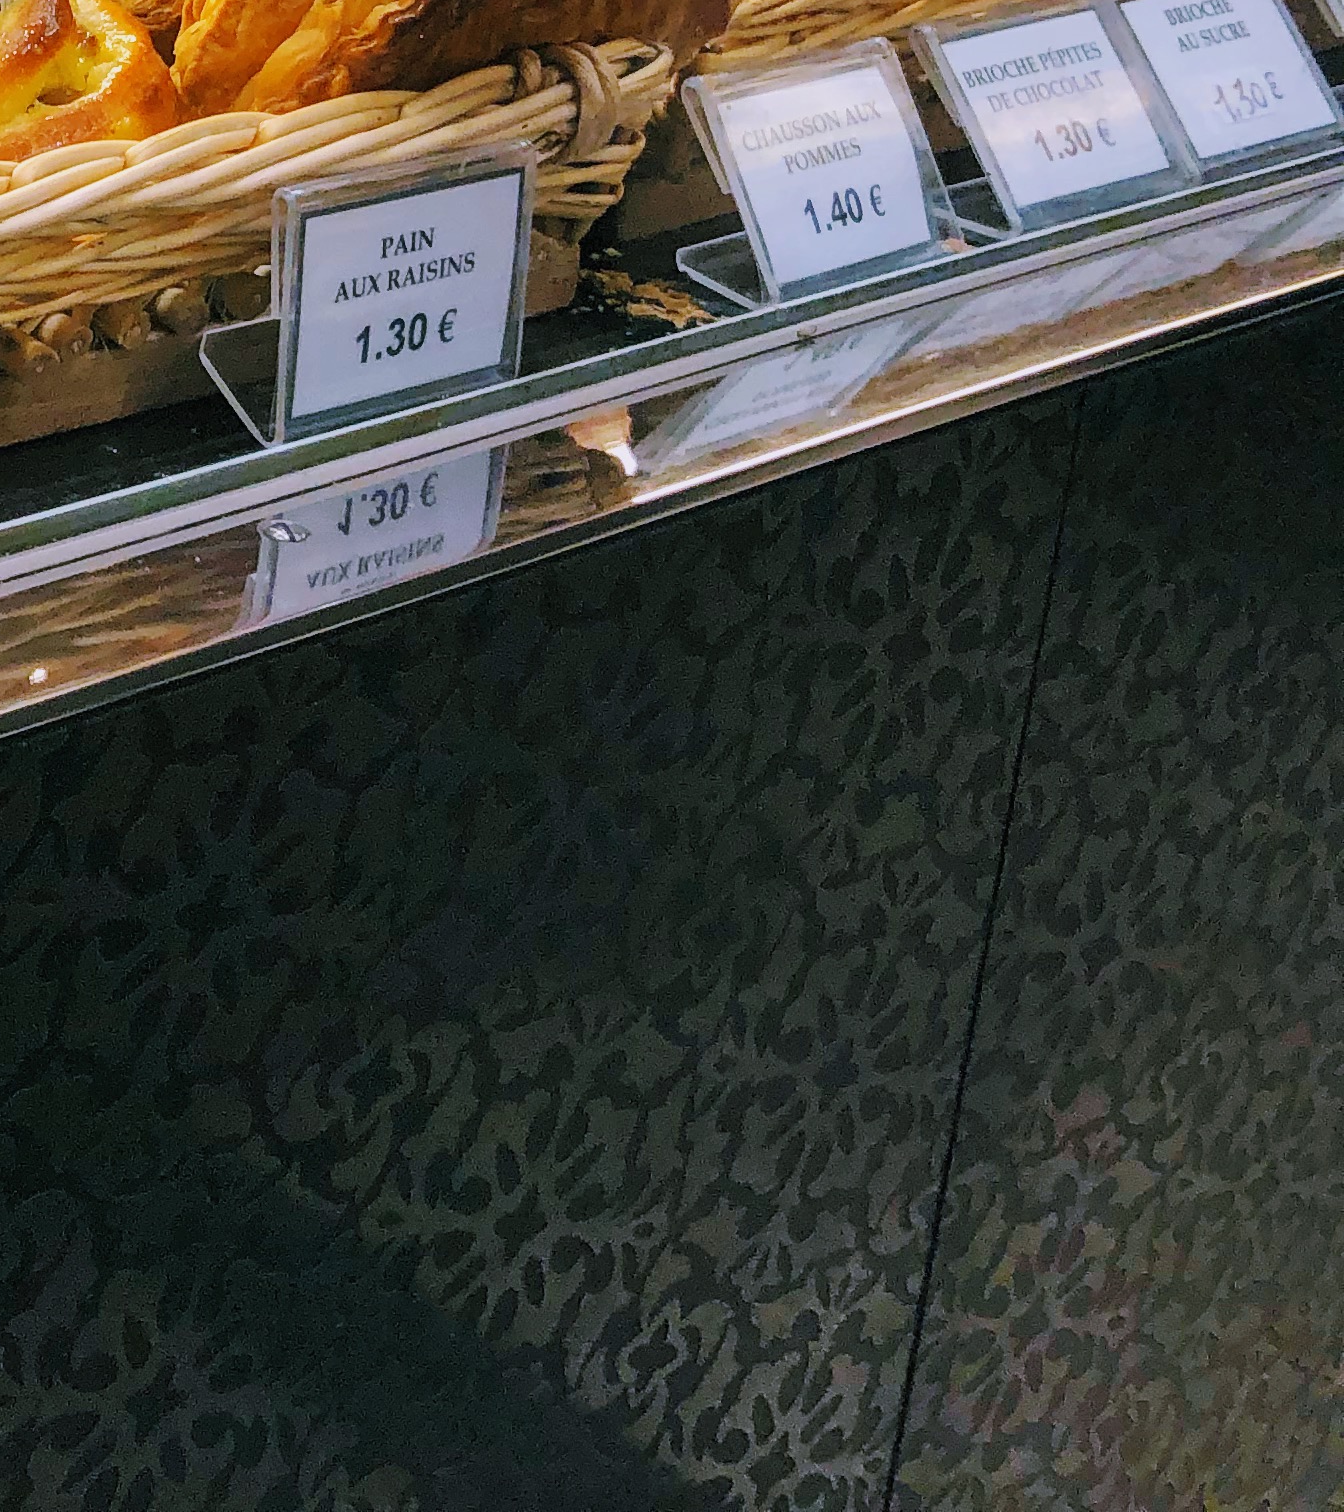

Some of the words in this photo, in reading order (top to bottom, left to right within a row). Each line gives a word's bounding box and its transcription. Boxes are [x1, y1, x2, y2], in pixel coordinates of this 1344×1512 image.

[1176, 33, 1200, 52] AU
[1199, 20, 1251, 45] SUCRE
[962, 56, 1040, 88] BRIOCHE
[1039, 41, 1102, 71] PÉPITES
[987, 94, 1014, 113] DE
[1013, 69, 1104, 106] CHOCOLAT
[742, 110, 841, 152] CHAUSSON
[845, 101, 882, 125] AUX
[1034, 119, 1093, 162] 1.30
[1096, 118, 1116, 147] €
[783, 137, 861, 174] POMMES
[804, 187, 863, 234] 1.40
[869, 184, 886, 216] €
[380, 227, 436, 259] PAIN
[334, 275, 381, 303] AUX
[386, 252, 475, 292] RAISINS
[356, 312, 428, 364] 1.30
[438, 308, 458, 343] €
